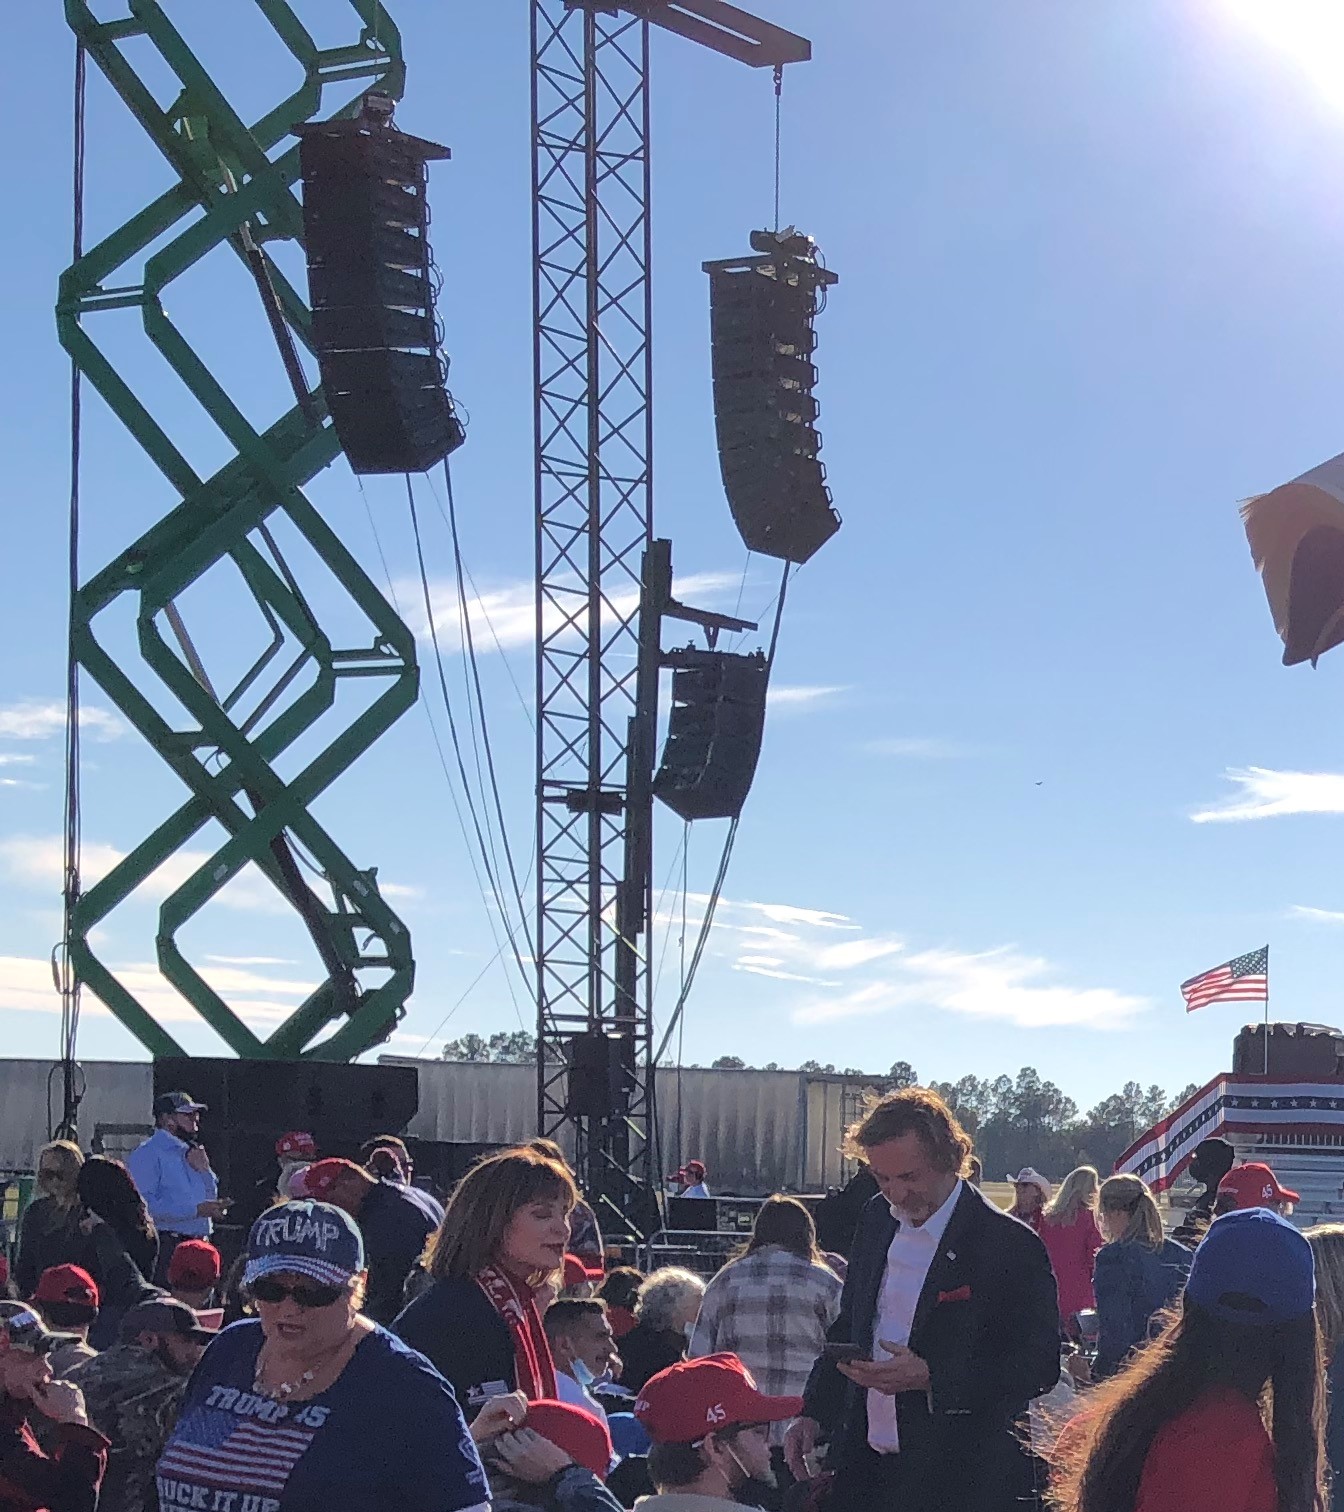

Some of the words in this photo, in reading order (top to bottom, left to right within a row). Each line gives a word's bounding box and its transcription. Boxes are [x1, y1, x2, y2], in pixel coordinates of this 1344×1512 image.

[1261, 1183, 1274, 1199] 45
[255, 1215, 340, 1252] TRUMP
[205, 1385, 289, 1423] TRUMP
[706, 1403, 726, 1423] 45
[211, 1489, 238, 1512] IT
